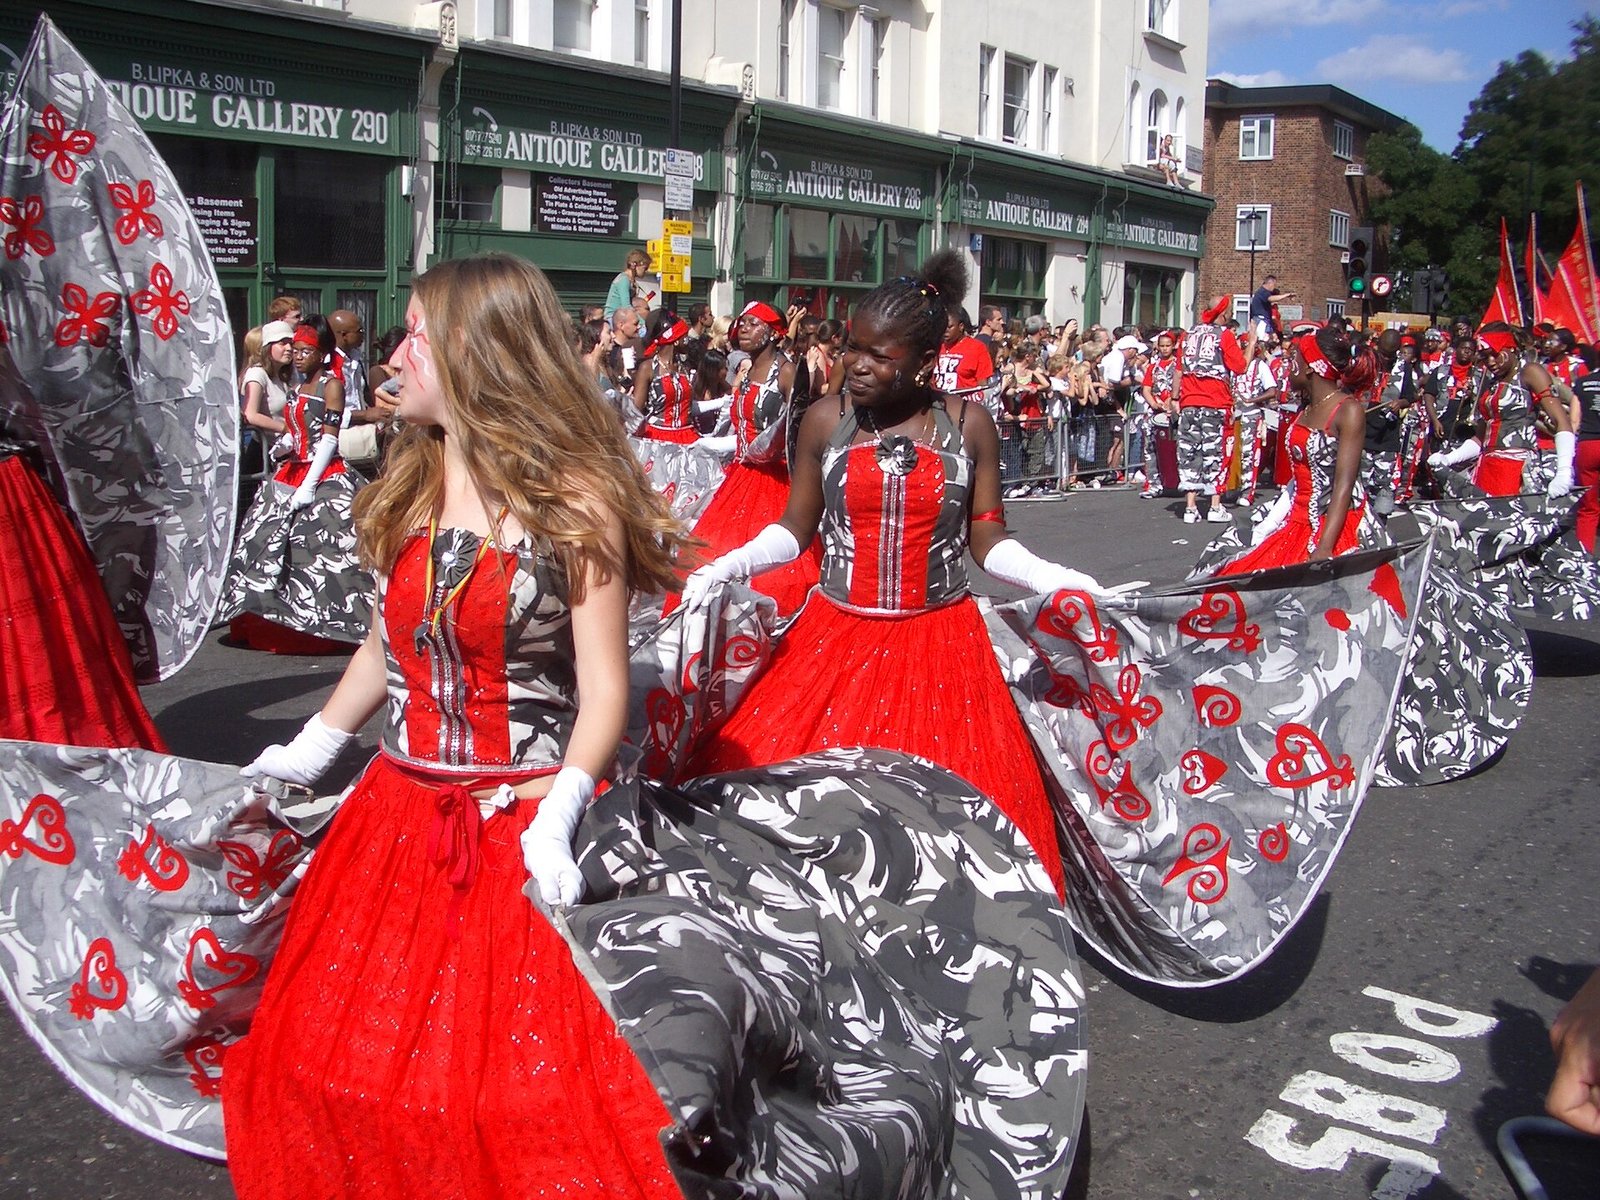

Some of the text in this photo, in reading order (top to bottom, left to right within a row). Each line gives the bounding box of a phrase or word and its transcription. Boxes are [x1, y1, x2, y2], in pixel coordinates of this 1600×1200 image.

[200, 72, 210, 88] &
[216, 74, 243, 92] SON
[250, 79, 275, 96] LTD
[213, 94, 343, 138] GALLERY
[352, 109, 388, 144] 290
[593, 129, 600, 139] &
[602, 130, 622, 142] SON
[626, 132, 642, 146] LTD
[504, 132, 592, 170] ANTIQUE
[840, 167, 844, 176] &
[846, 166, 859, 178] SON
[861, 169, 872, 180] LTD
[548, 176, 612, 189] Collectors Basement
[564, 187, 592, 196] Advertising
[786, 170, 921, 210] ANTIQUE GALLERY 286
[197, 196, 243, 207] Basement
[572, 195, 598, 204] Packaging
[574, 203, 602, 211] Collectable
[562, 210, 595, 218] Gramophones
[986, 200, 1030, 225] ANTIQUE
[1033, 209, 1073, 232] GALLERY
[1077, 215, 1089, 234] 284
[231, 219, 251, 227] Signs
[577, 218, 600, 227] Cigarette
[1124, 224, 1155, 244] ANTIQUE
[1158, 230, 1188, 250] GALLERY
